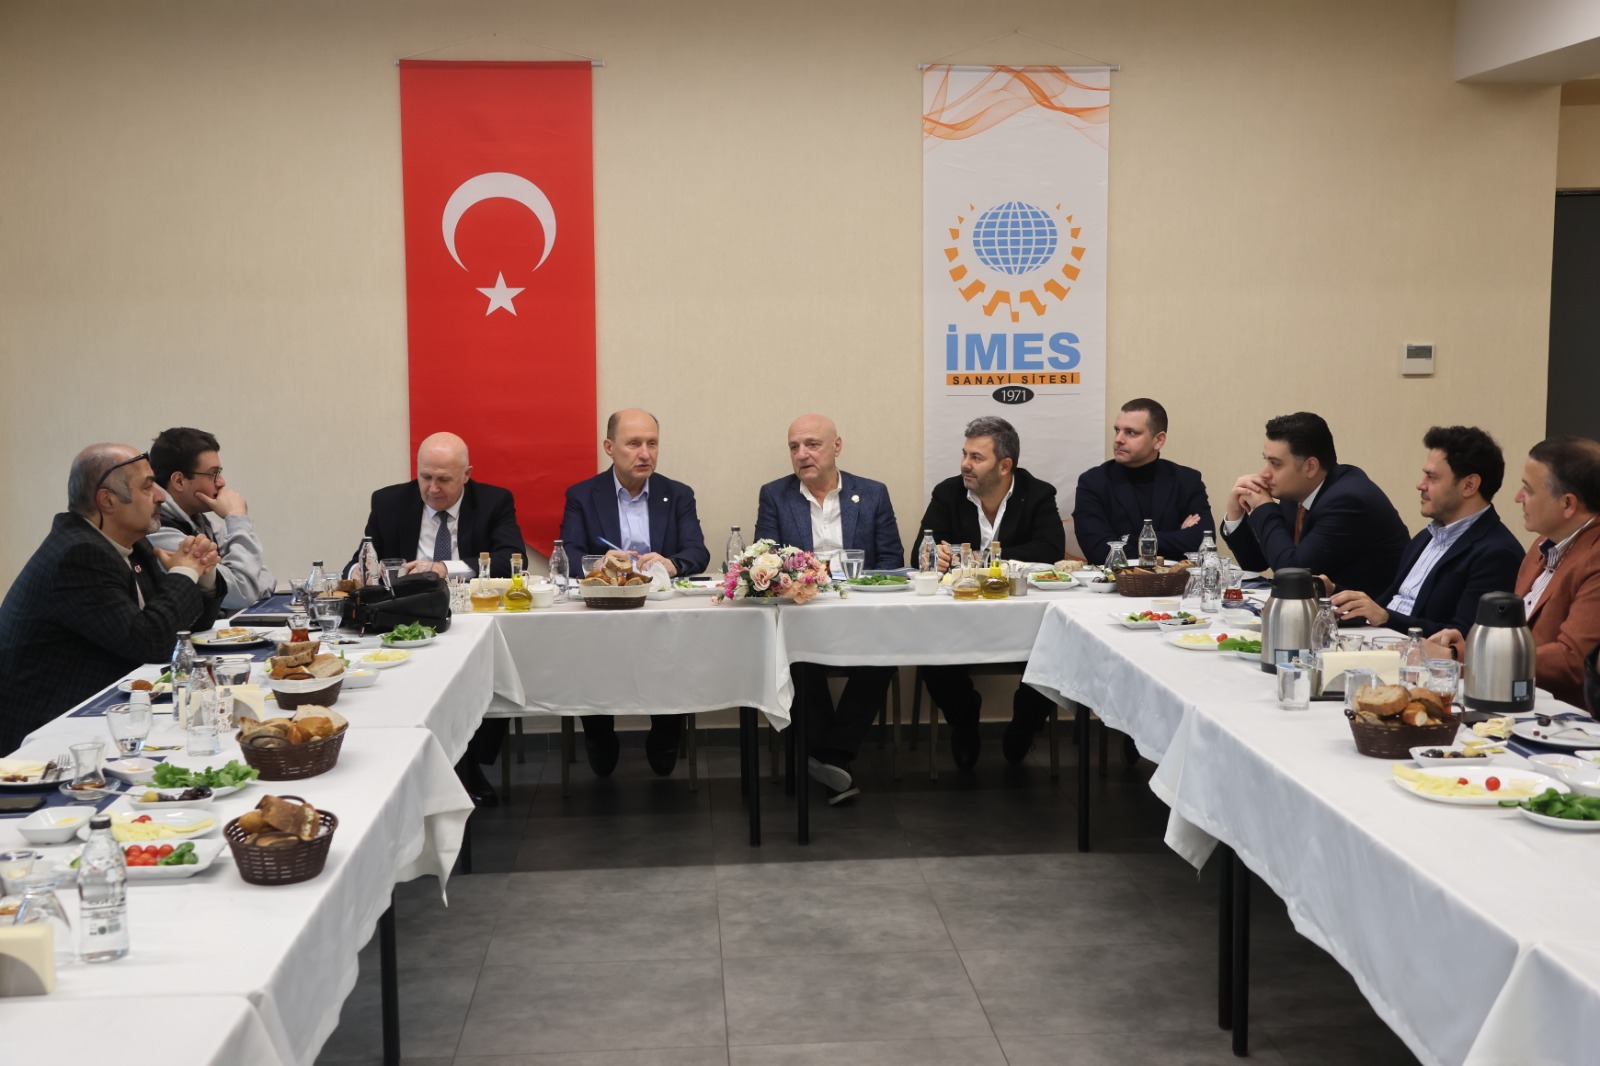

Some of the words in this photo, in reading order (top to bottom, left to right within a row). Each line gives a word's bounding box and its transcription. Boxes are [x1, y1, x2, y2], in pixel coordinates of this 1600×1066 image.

[946, 324, 1081, 371] İMES
[952, 374, 1011, 385] SANAYİ
[1021, 373, 1074, 384] SİTESİ
[1001, 390, 1026, 401] 1971
